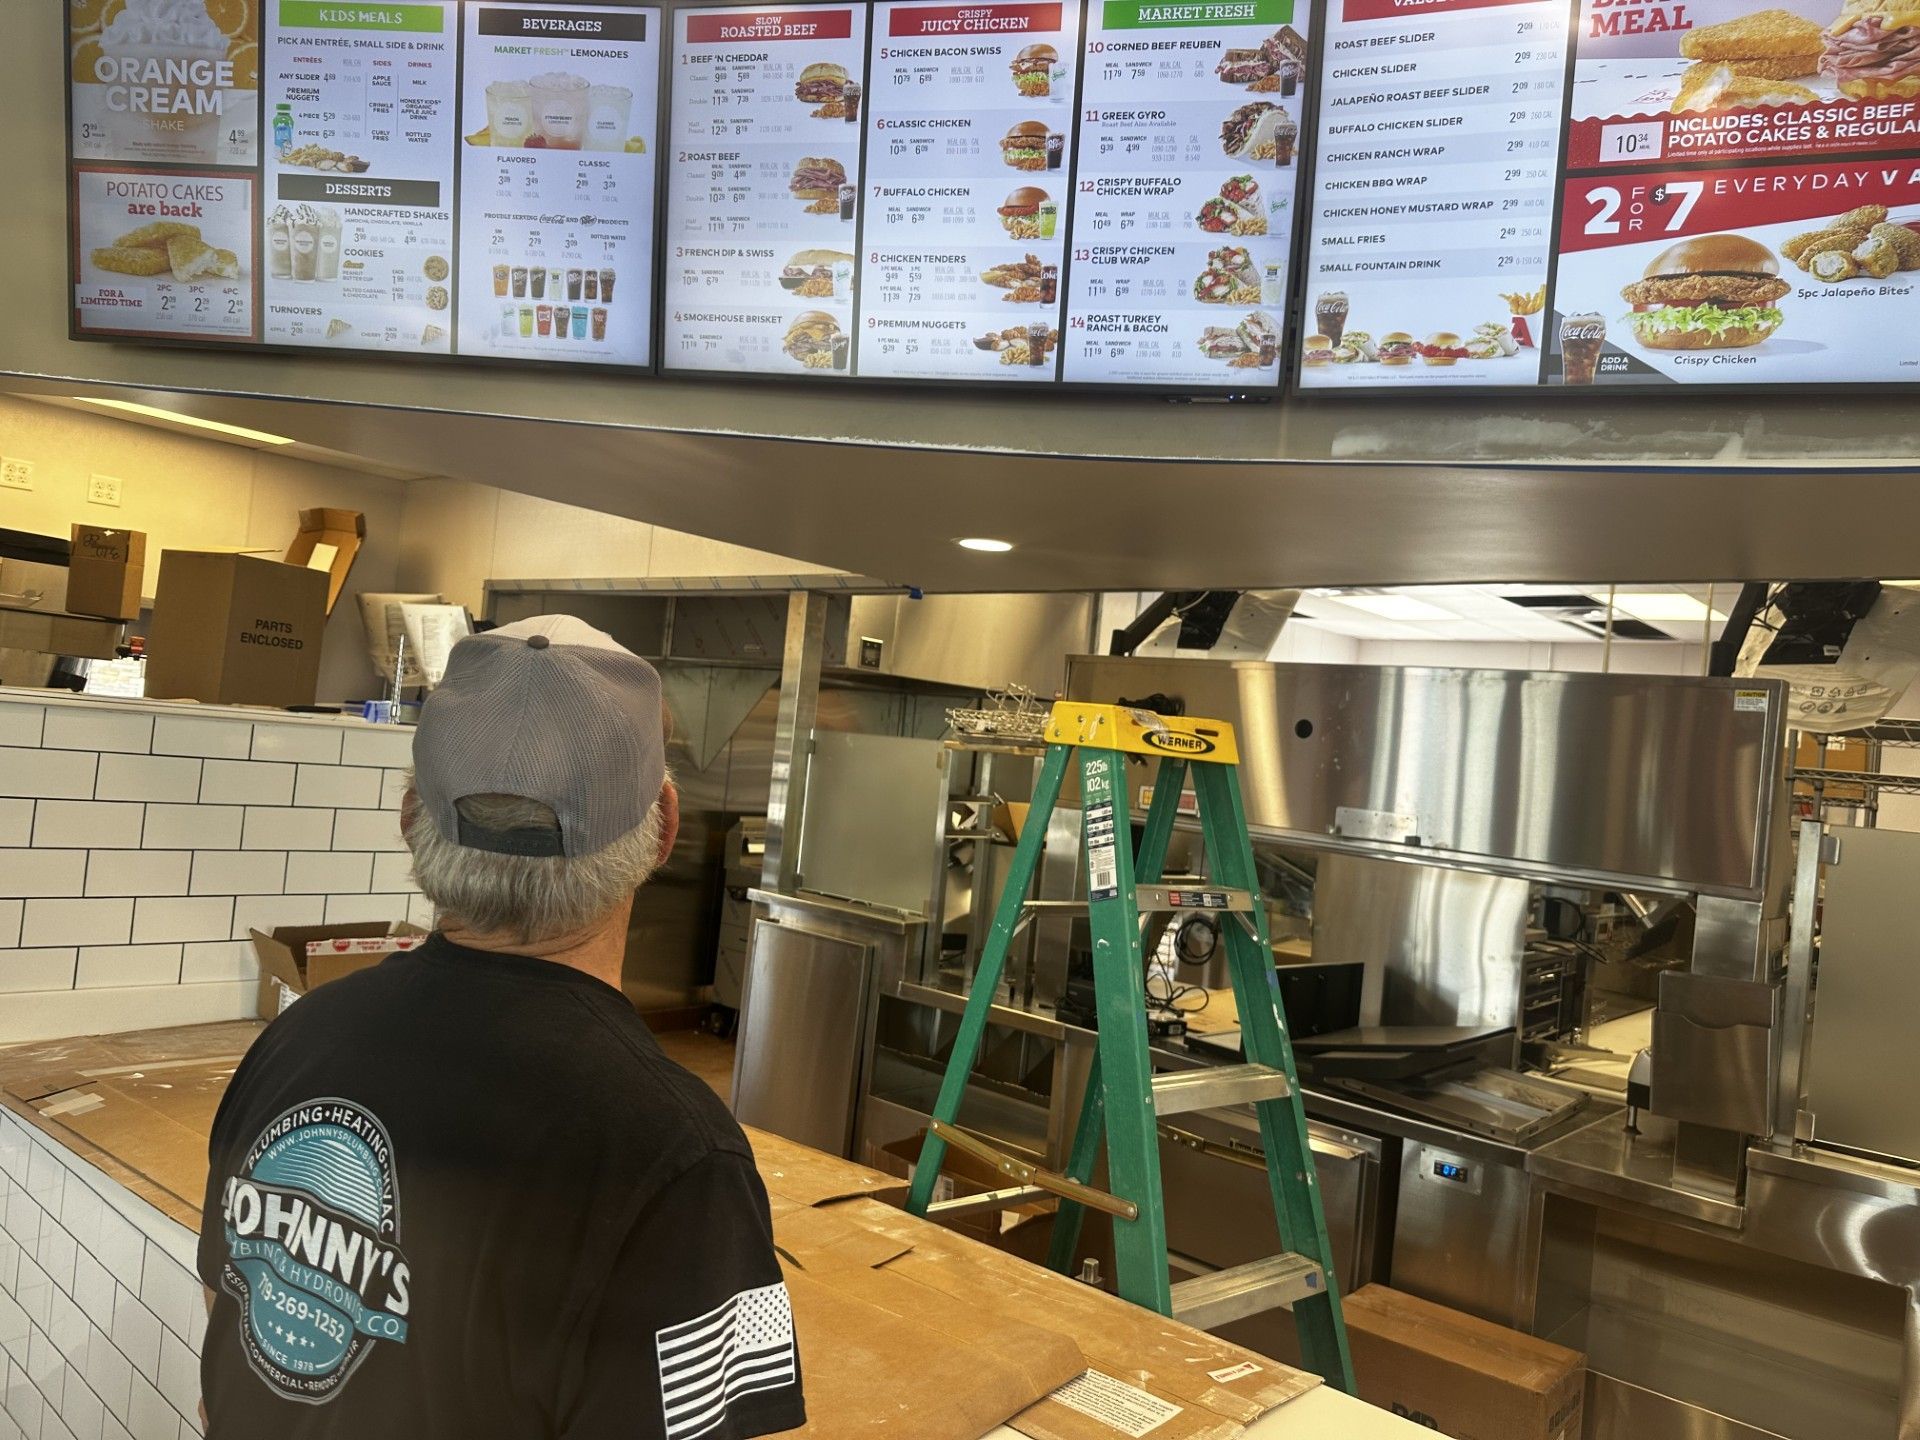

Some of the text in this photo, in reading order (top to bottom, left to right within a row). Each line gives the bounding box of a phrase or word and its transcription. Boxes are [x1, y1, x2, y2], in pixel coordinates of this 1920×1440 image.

[320, 10, 402, 24] KIDS MEALS
[958, 10, 992, 18] CRISPY
[1139, 5, 1255, 20] MARKET FRESH
[523, 19, 602, 31] BEVERAGES
[756, 17, 781, 25] SLOW
[921, 17, 1029, 32] JUICY CHICKEN
[1589, 6, 1692, 38] MEAL
[721, 24, 817, 38] ROASTED BEEF
[278, 37, 298, 45] PICK
[353, 40, 383, 48] SMALL
[416, 42, 444, 50] DRINK
[1088, 41, 1221, 53] 10 CORNED BEEF REUBEN
[1334, 32, 1435, 50] ROAST BEEF SLIDER
[494, 46, 628, 58] MARKET LEMONADES
[881, 48, 888, 59] 5
[890, 50, 932, 58] CHICKEN
[970, 47, 1002, 55] SWISS
[682, 54, 768, 64] 1 BEEF CHEDDAR
[94, 57, 234, 87] ORANGE
[1332, 63, 1417, 78] CHICKEN SLIDER
[106, 85, 222, 115] CREAM
[1330, 85, 1489, 107] JALAPEÑO ROAST BEEF SLIDER
[1086, 111, 1166, 122] 11 GREEK GYRO
[1669, 103, 1915, 133] INCLUDES: CLASSIC BEEF
[877, 119, 971, 130] 6 CLASSIC CHICKEN
[1329, 117, 1463, 134] BUFFALO CHICKEN SLIDER
[1668, 131, 1741, 148] POTATO
[1746, 128, 1813, 143] CAKES
[1816, 126, 1830, 139] &
[497, 156, 536, 164] FLAVORED
[679, 152, 686, 162] 2
[687, 153, 716, 161] ROAST
[1327, 146, 1445, 162] CHICKEN RANCH WRAP
[579, 160, 610, 168] CLASSIC
[1080, 181, 1094, 192] 12
[1135, 178, 1181, 186] BUFFALO
[1325, 176, 1427, 190] CHICKEN BBQ WRAP
[107, 182, 223, 201] POTATO CAKES
[325, 183, 391, 197] DESSERTS
[874, 187, 970, 197] 7 BUFFALO CHICKEN
[1096, 187, 1174, 196] CHICKEN WRAP
[128, 201, 202, 217] are back
[1323, 201, 1494, 218] CHICKEN HONEY MUSTARD WRAP
[1584, 172, 1868, 235] 2 EVERYDAY
[344, 208, 449, 220] HANDCRAFTED SHAKES
[1321, 234, 1386, 245] SMALL FRIES
[344, 249, 384, 257] COOKIES
[676, 247, 683, 257] 3
[685, 249, 720, 257] FRENCH
[722, 249, 735, 257] DIP
[746, 249, 774, 258] SWISS
[871, 253, 966, 263] 8 CHICKEN TENDERS
[1075, 247, 1175, 261] 13 CRISPY CHICKEN
[1092, 256, 1117, 264] CLUB
[1320, 259, 1441, 272] SMALL FOUNTAIN DRINK
[99, 289, 123, 298] FOR A
[1797, 286, 1877, 300] 5pc Jalapeño
[81, 297, 142, 307] LIMITED TIME
[270, 306, 322, 315] TURNOVERS
[674, 311, 782, 323] 4 SMOKEHOUSE BRISKET
[868, 318, 966, 329] 9 PREMIUM NUGGETS
[1070, 315, 1161, 328] 14 ROAST TURKEY
[1087, 324, 1168, 333] RANCH & BACON
[1674, 354, 1757, 365] Crispy Chicken
[255, 619, 293, 634] PARTS
[240, 632, 304, 650] ENCLOSED
[1157, 736, 1202, 749] WERNER
[1087, 777, 1100, 792] 102
[261, 1339, 287, 1364] SINCE
